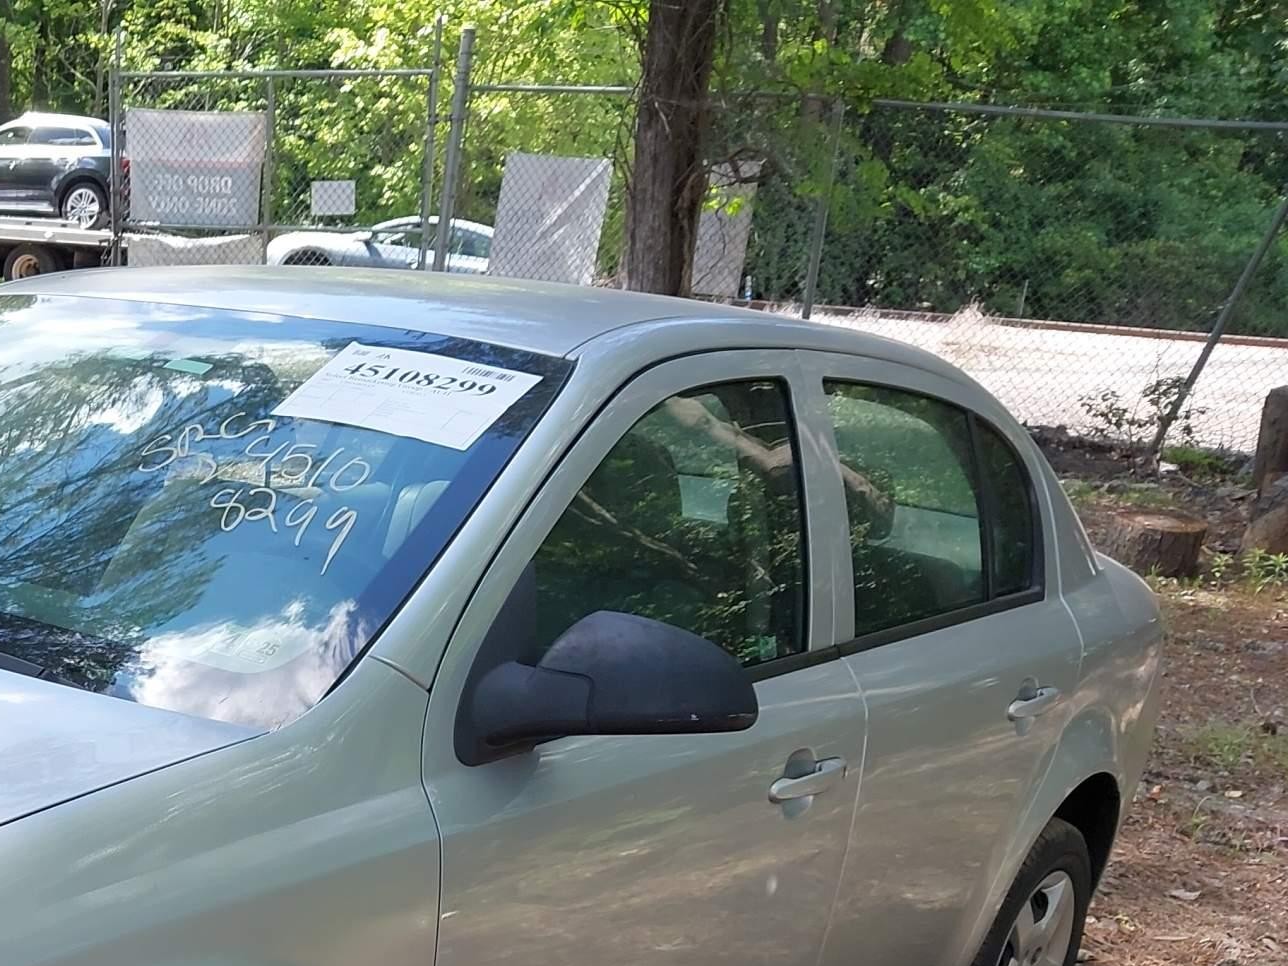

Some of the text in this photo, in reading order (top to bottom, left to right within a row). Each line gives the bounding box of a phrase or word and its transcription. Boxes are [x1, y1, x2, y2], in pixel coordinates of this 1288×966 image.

[344, 362, 497, 396] 45108299
[244, 435, 371, 491] 4510
[210, 487, 358, 576] 8299
